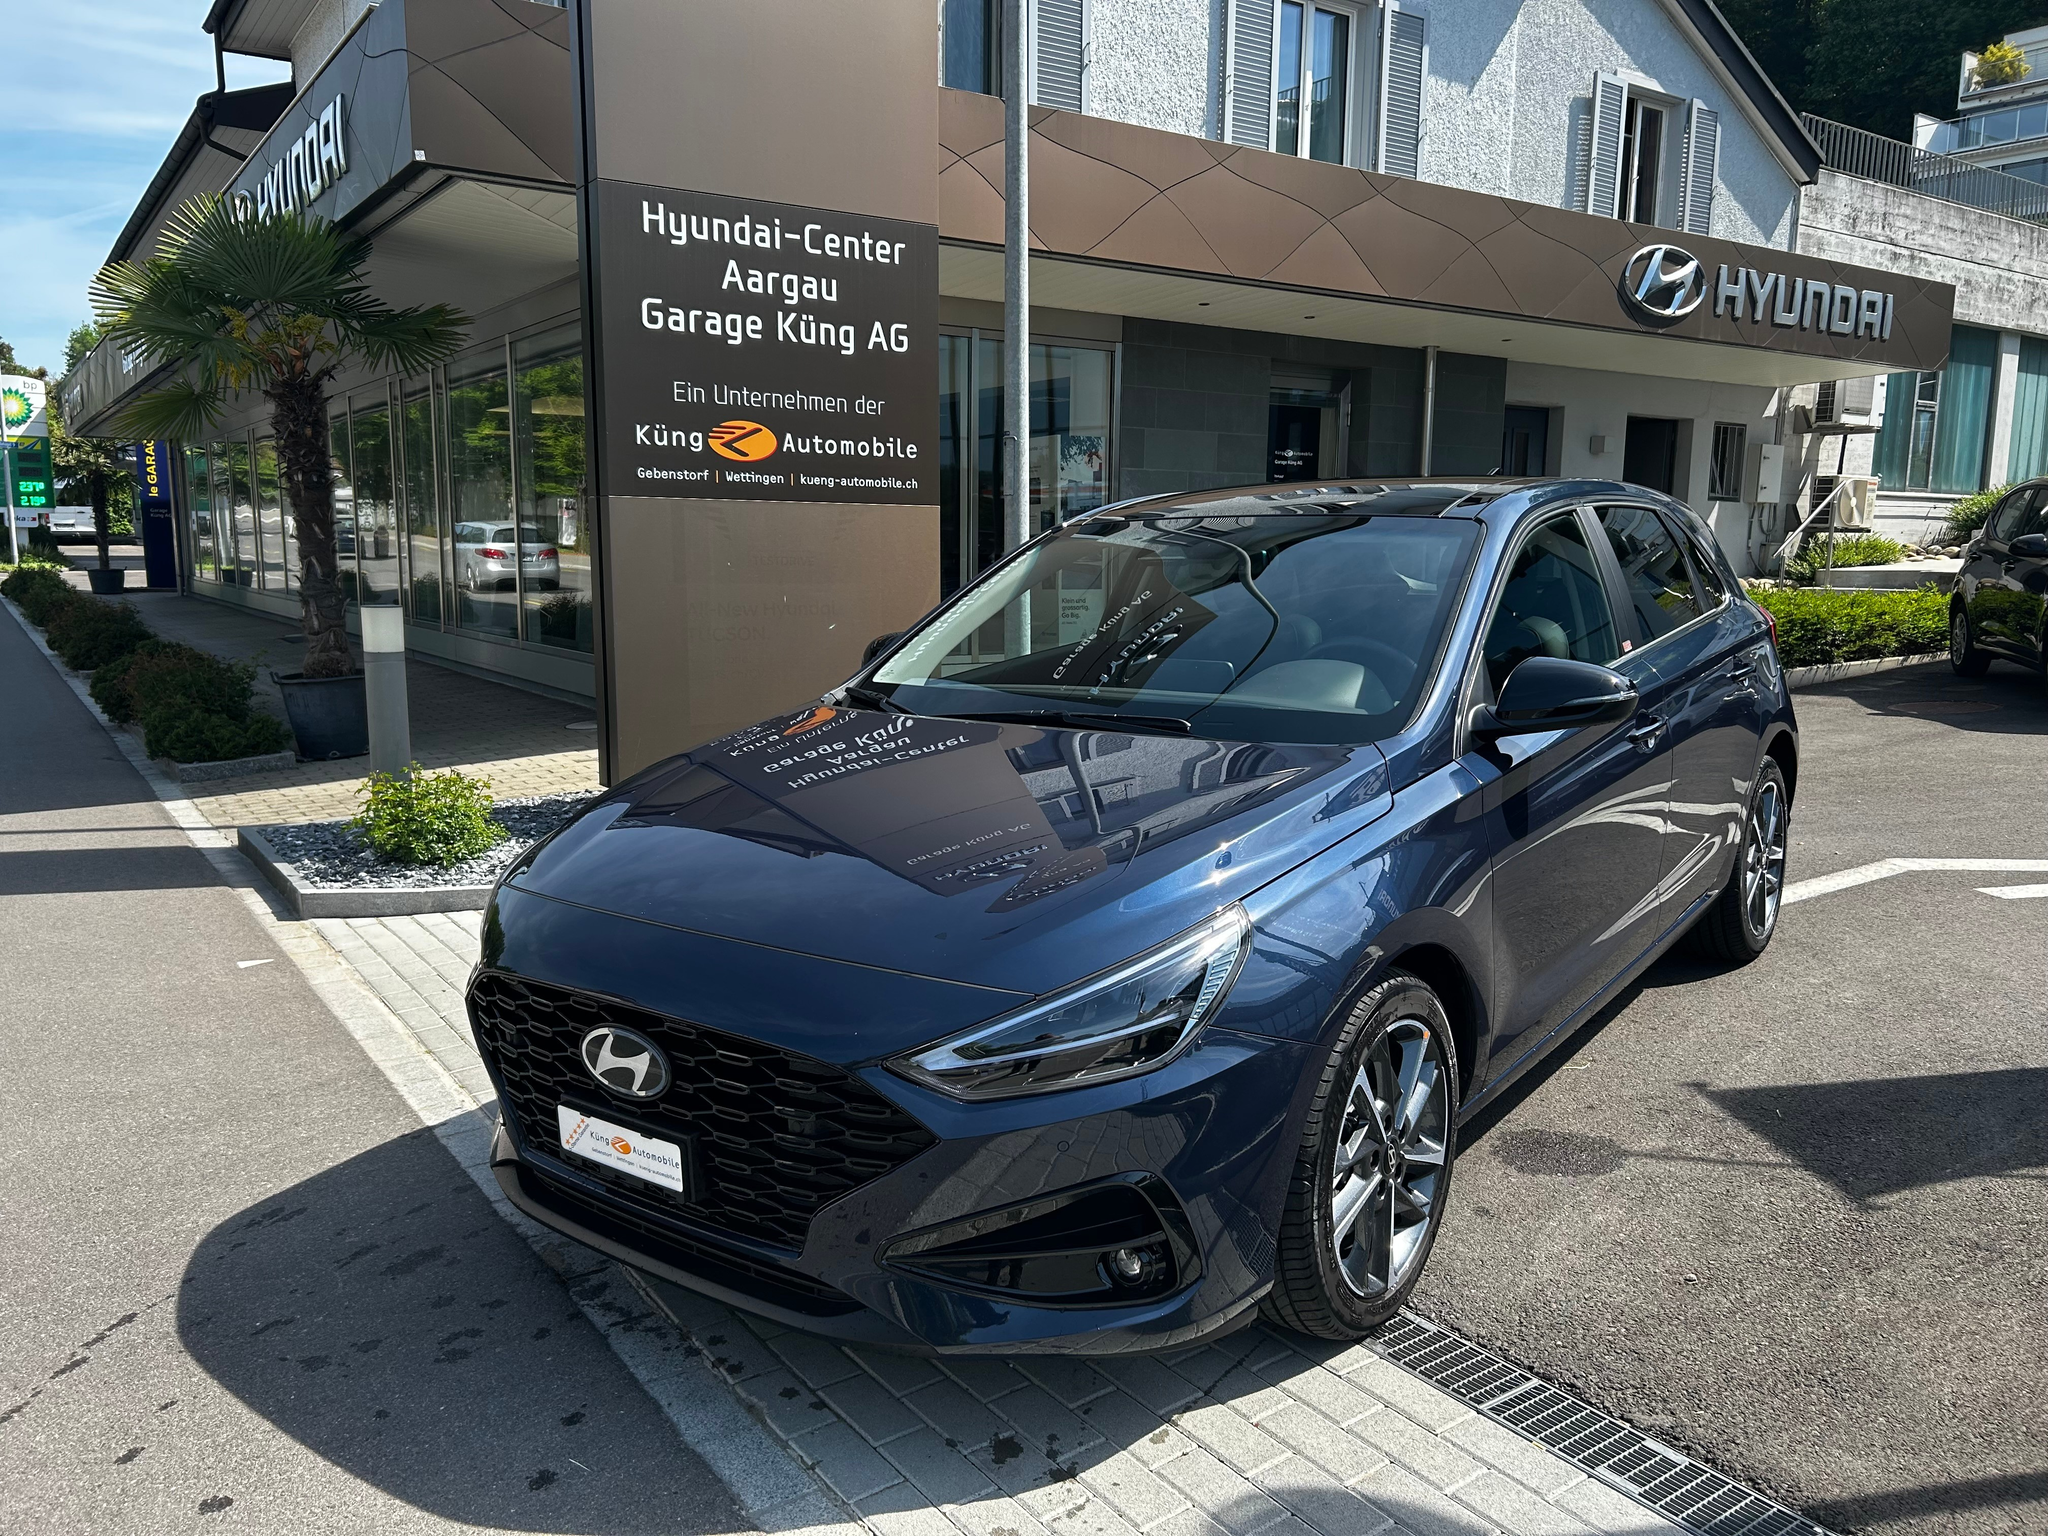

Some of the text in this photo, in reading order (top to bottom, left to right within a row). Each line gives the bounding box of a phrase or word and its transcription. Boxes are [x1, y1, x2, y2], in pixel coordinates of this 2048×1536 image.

[257, 93, 348, 225] HYUNDAI
[641, 200, 906, 265] Hyundai-Center
[721, 259, 838, 305] Aargau
[1714, 263, 1894, 341] HYUNDAI
[641, 297, 909, 355] Garage Küng AG
[23, 381, 37, 391] bp
[673, 380, 885, 416] Ein Unternehmen der
[636, 424, 918, 459] Küng Automobile
[636, 467, 918, 490] Gebenstorf Wettingen kueng-automobile.ch
[589, 1130, 680, 1169] Küng Automobile
